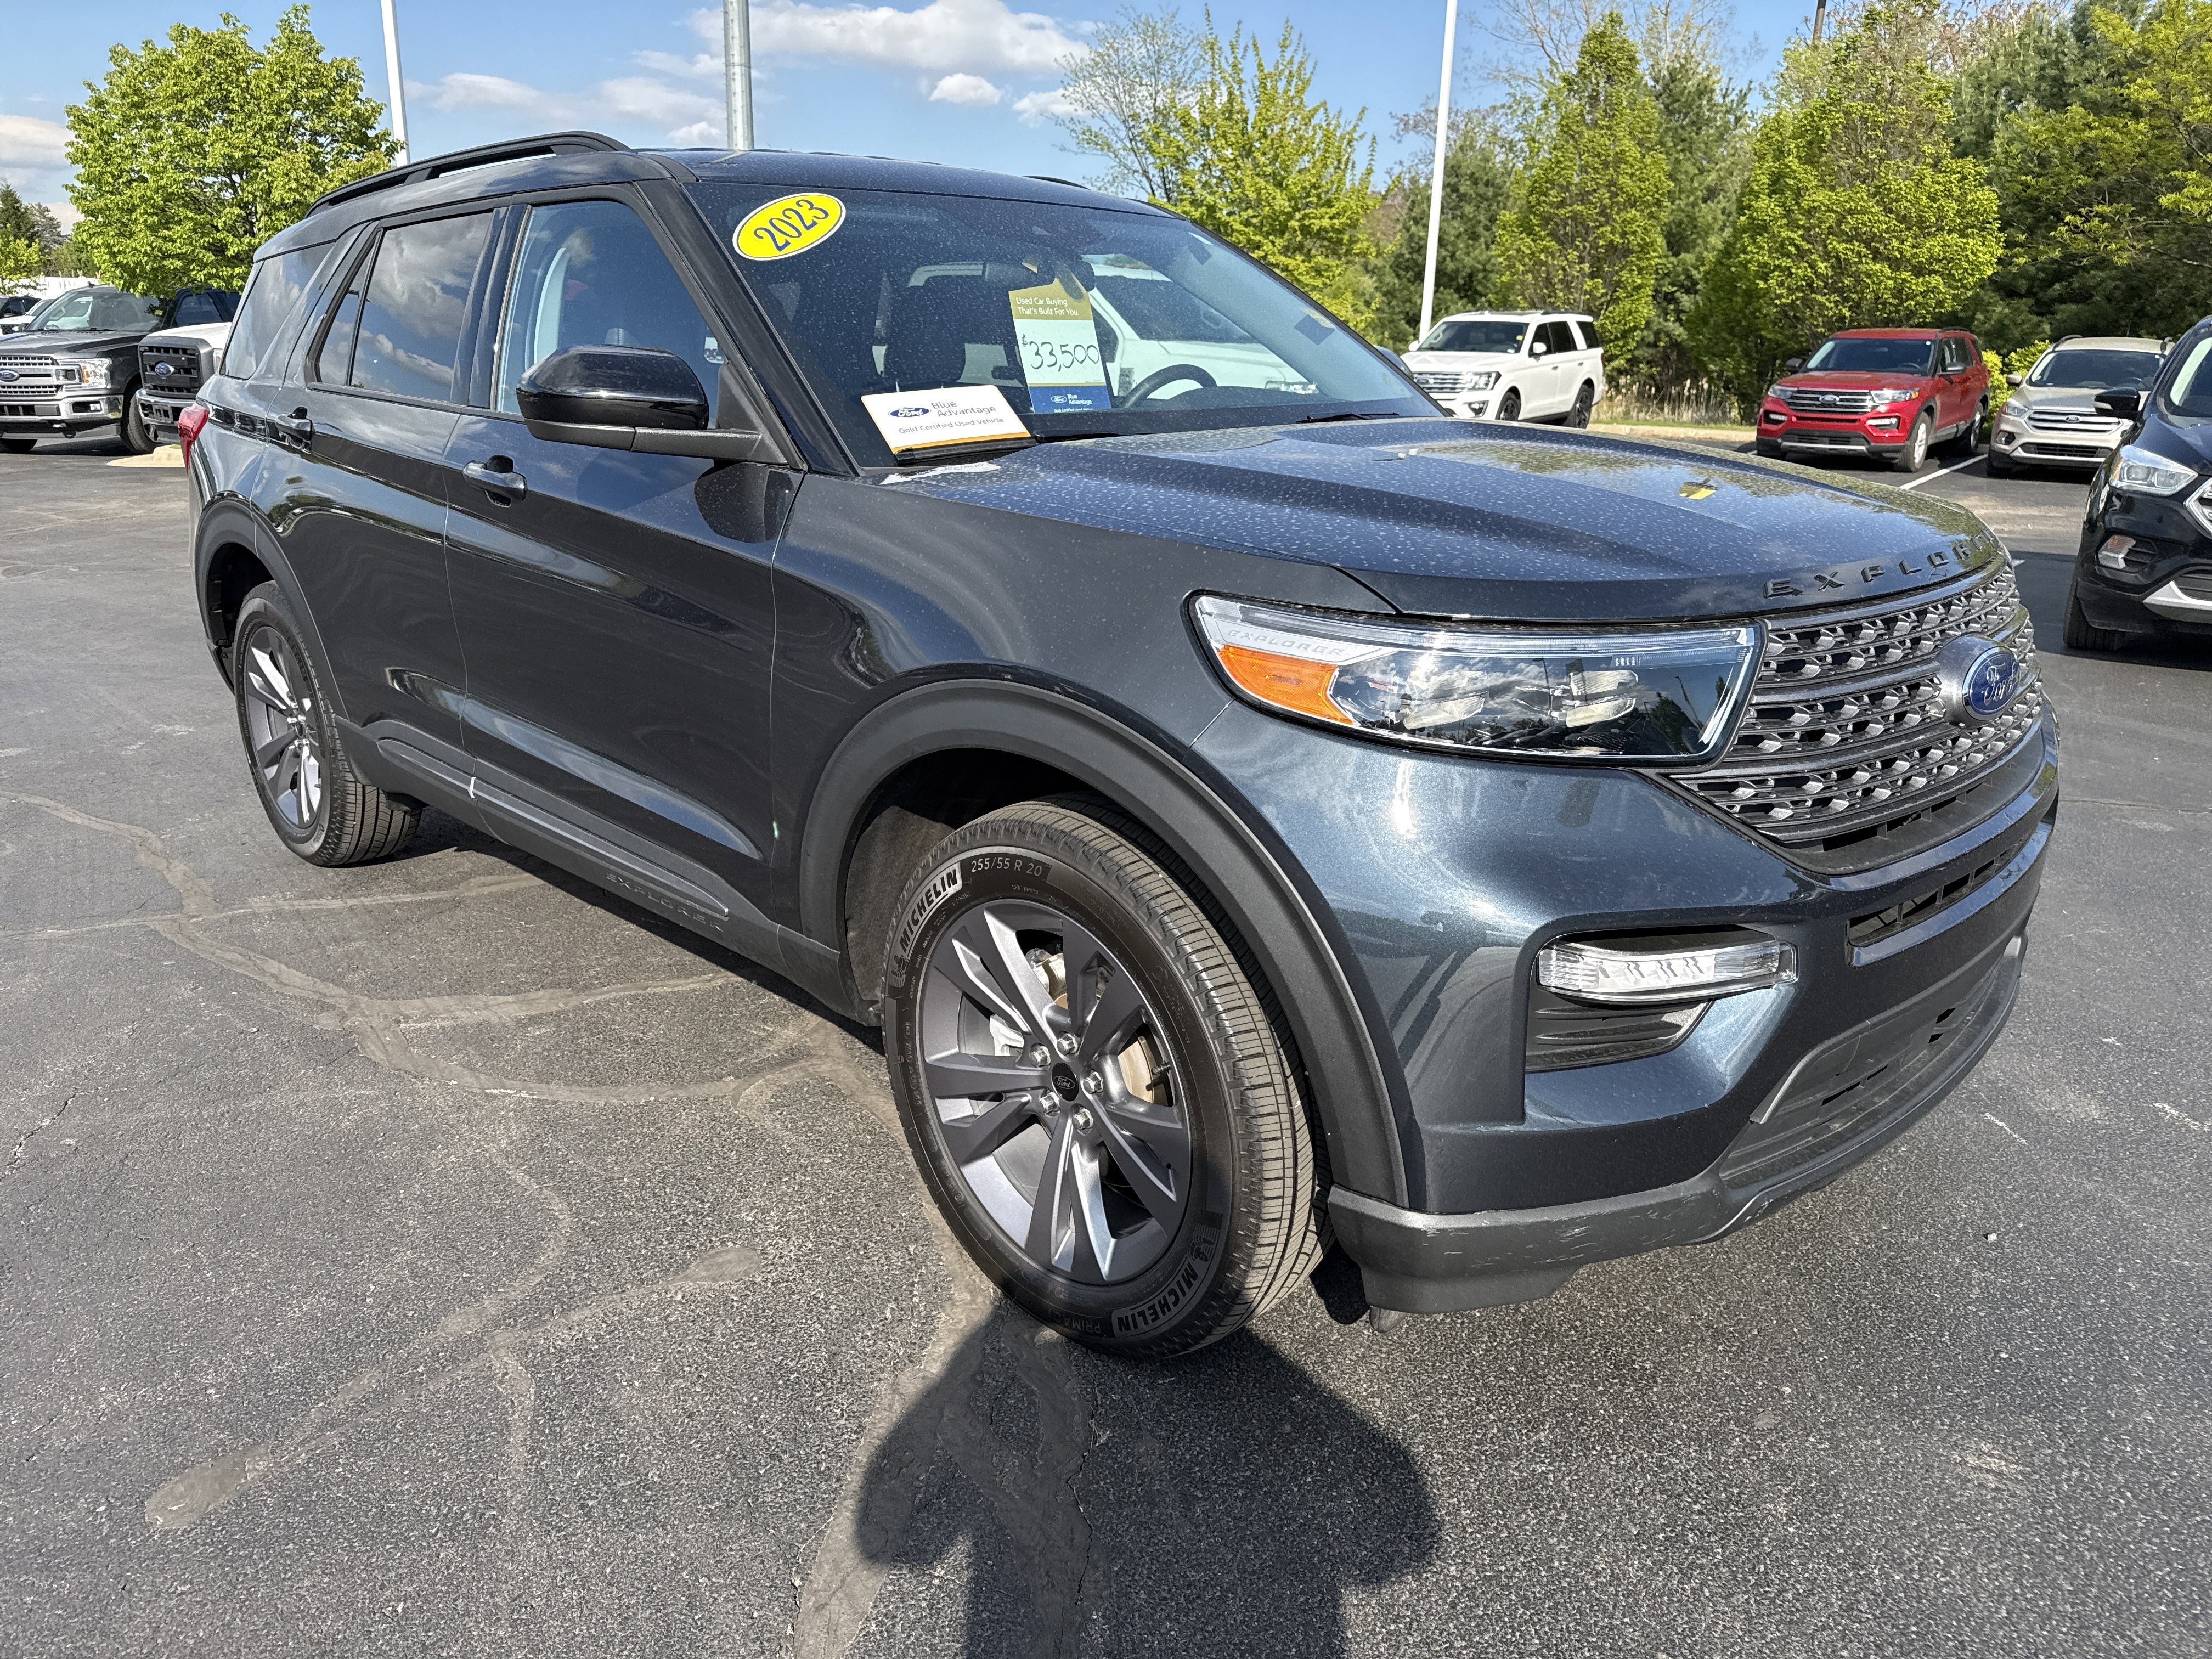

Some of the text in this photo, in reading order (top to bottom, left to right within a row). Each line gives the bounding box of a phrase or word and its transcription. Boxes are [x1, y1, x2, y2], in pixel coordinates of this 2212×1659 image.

[753, 199, 830, 252] 2023
[1015, 296, 1068, 307] Used Car Buying
[1017, 307, 1037, 315] That's
[1022, 333, 1099, 372] $33,500
[898, 407, 924, 417] Ford
[930, 400, 958, 410] Blue
[937, 405, 997, 417] Advantage
[919, 421, 953, 432] Certified
[1227, 629, 1345, 656] EXPLORER
[1981, 660, 2019, 706] Ford
[970, 857, 1042, 877] 255/55 R 20
[606, 872, 724, 932] EXPLORER
[900, 869, 958, 953] MICHELIN
[1057, 1077, 1071, 1088] Ford
[1117, 1262, 1199, 1333] MICHELIN
